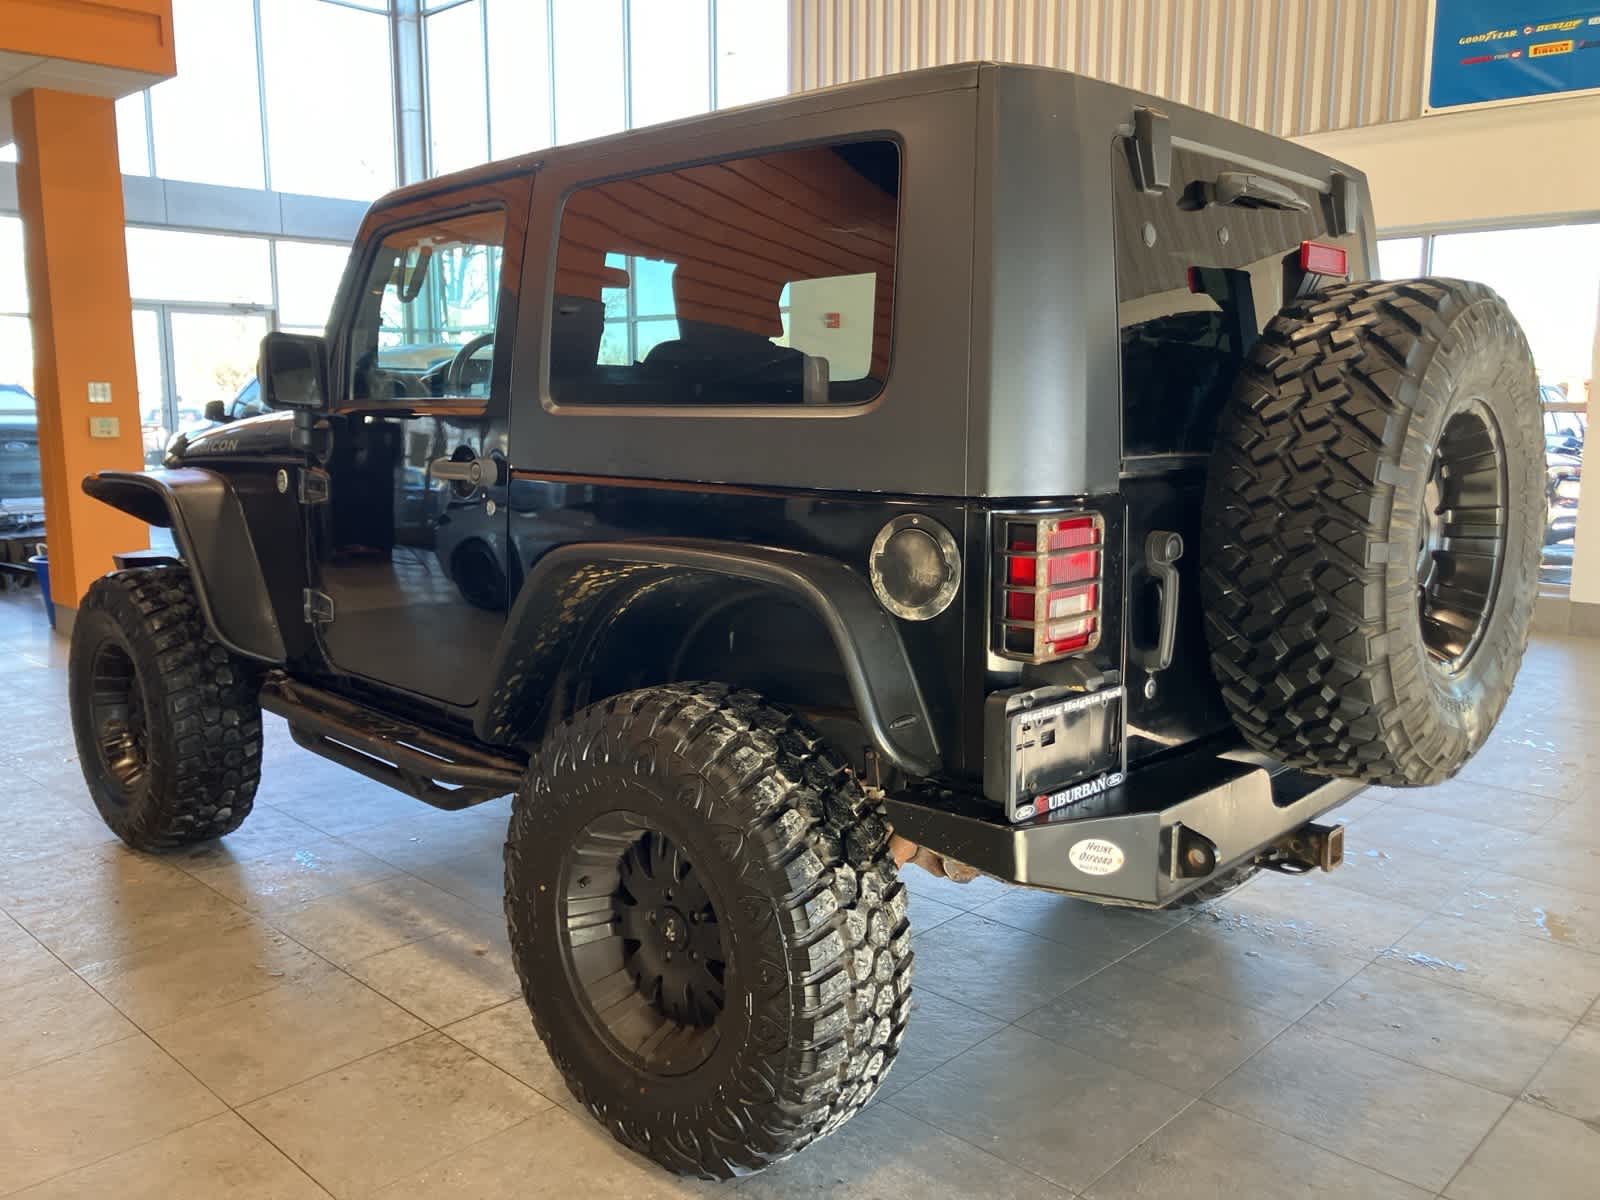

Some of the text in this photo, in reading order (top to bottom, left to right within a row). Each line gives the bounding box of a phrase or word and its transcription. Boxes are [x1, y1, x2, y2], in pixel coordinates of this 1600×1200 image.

[1459, 30, 1518, 45] GOODYEAR
[1536, 19, 1583, 32] DUNLOP
[1064, 695, 1101, 711] Heights
[1102, 686, 1122, 702] Ford
